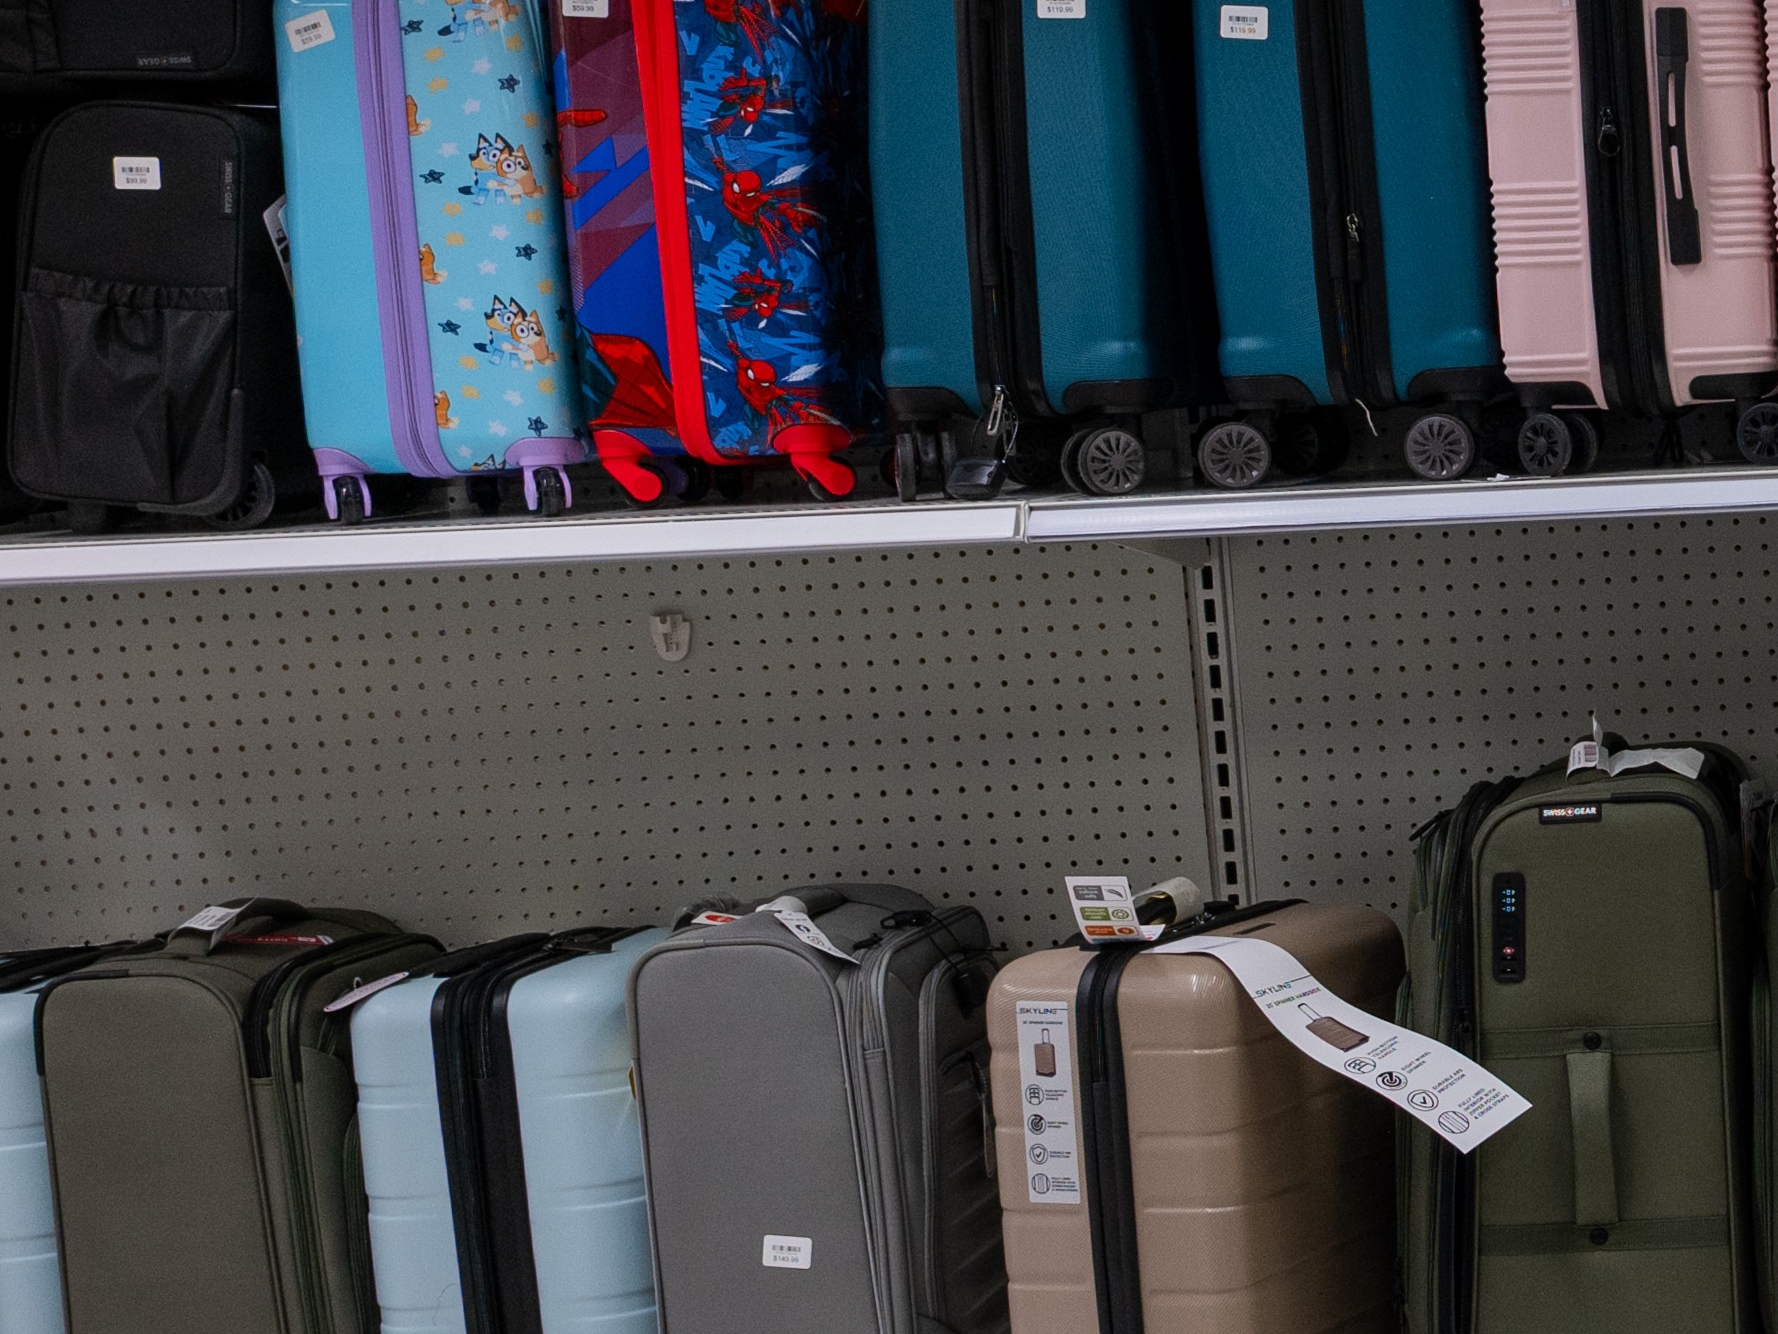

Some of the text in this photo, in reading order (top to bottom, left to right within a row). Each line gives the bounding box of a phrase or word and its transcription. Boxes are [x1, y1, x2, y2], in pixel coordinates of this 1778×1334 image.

[1543, 807, 1597, 816] SWISS GEAR
[1256, 982, 1292, 997] SKYLINE
